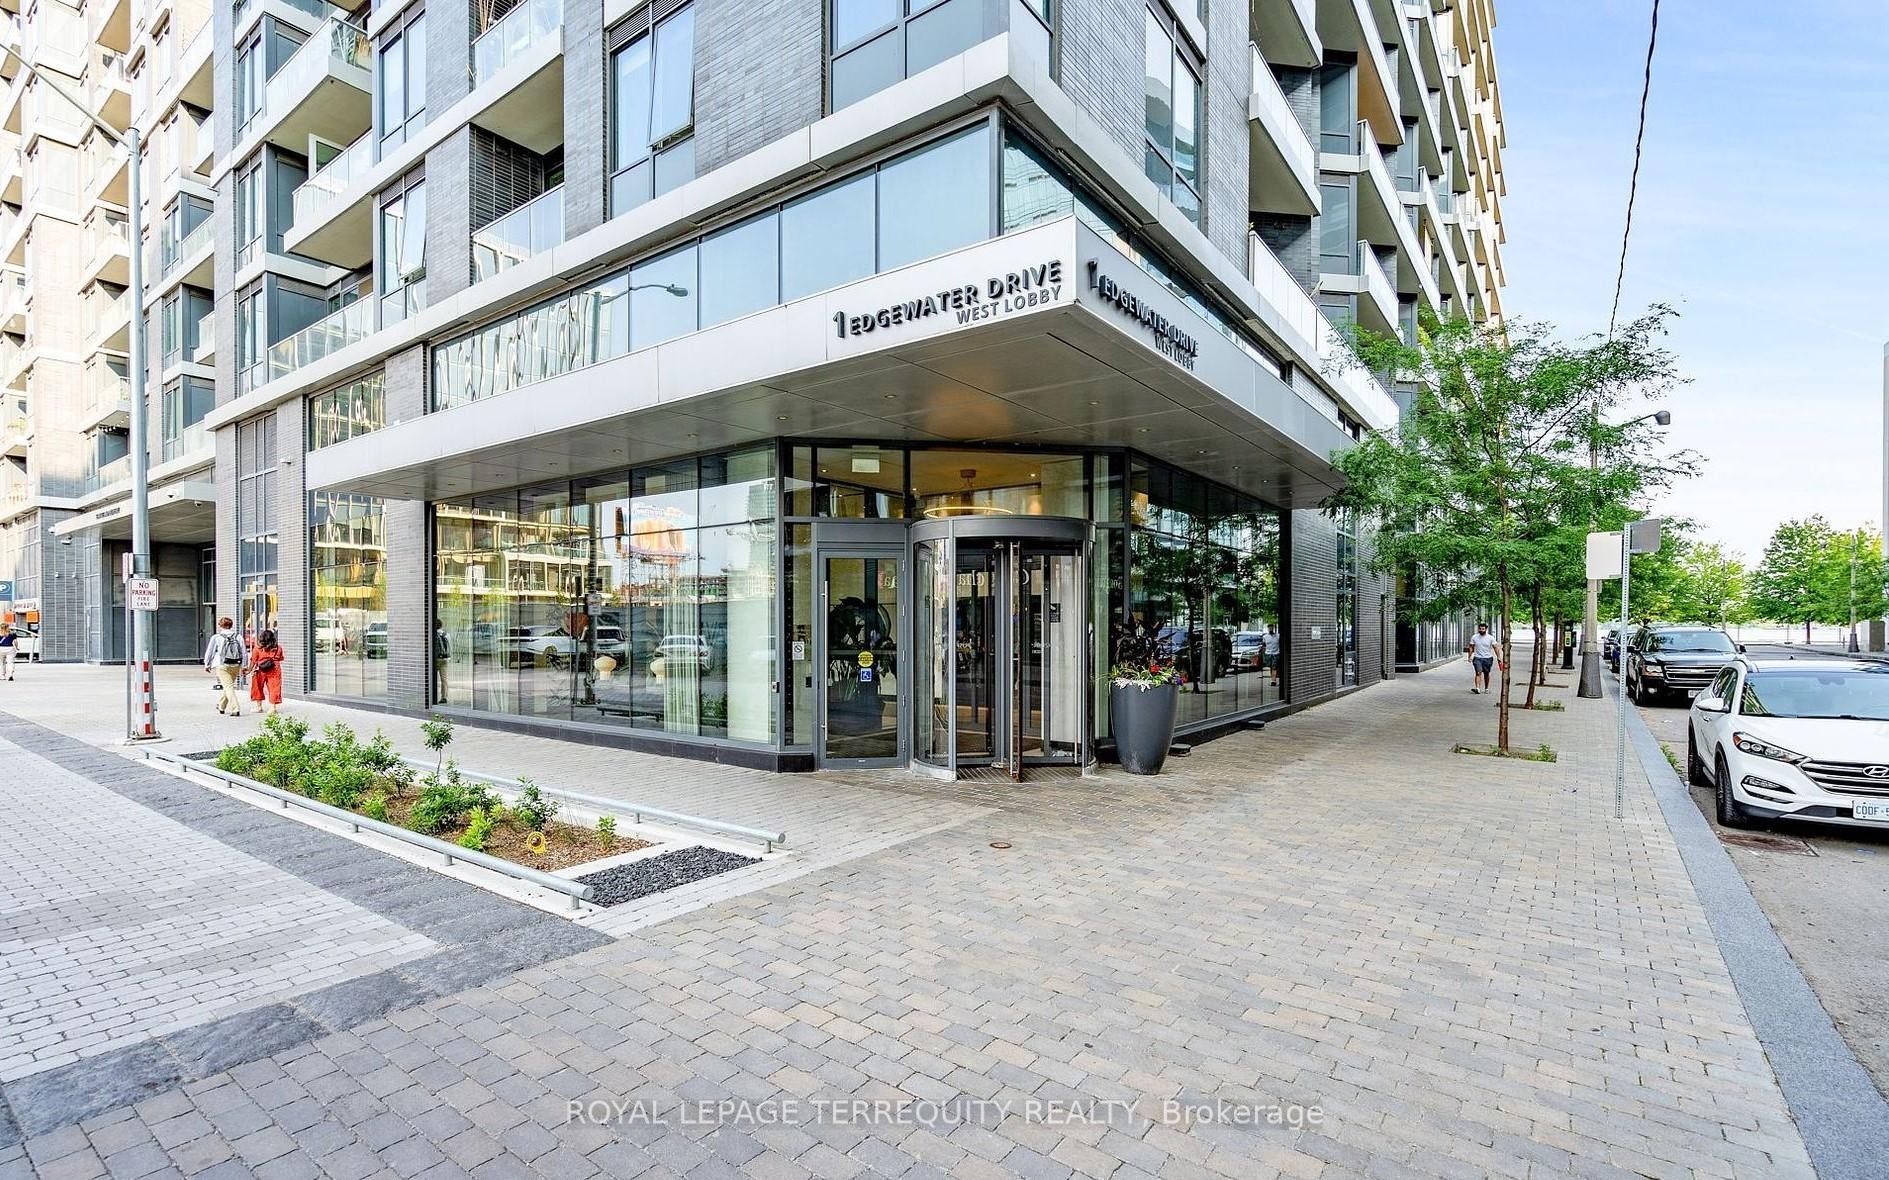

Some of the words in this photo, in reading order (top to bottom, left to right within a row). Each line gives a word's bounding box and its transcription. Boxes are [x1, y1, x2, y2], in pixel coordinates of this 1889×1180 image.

[833, 310, 846, 338] 1
[849, 284, 980, 336] EDGEWATER
[987, 259, 1062, 299] DRIVE
[956, 301, 999, 325] WEST
[1004, 285, 1061, 313] LOBBY
[1087, 259, 1099, 289] 1
[1099, 274, 1171, 338] EDGEWATER
